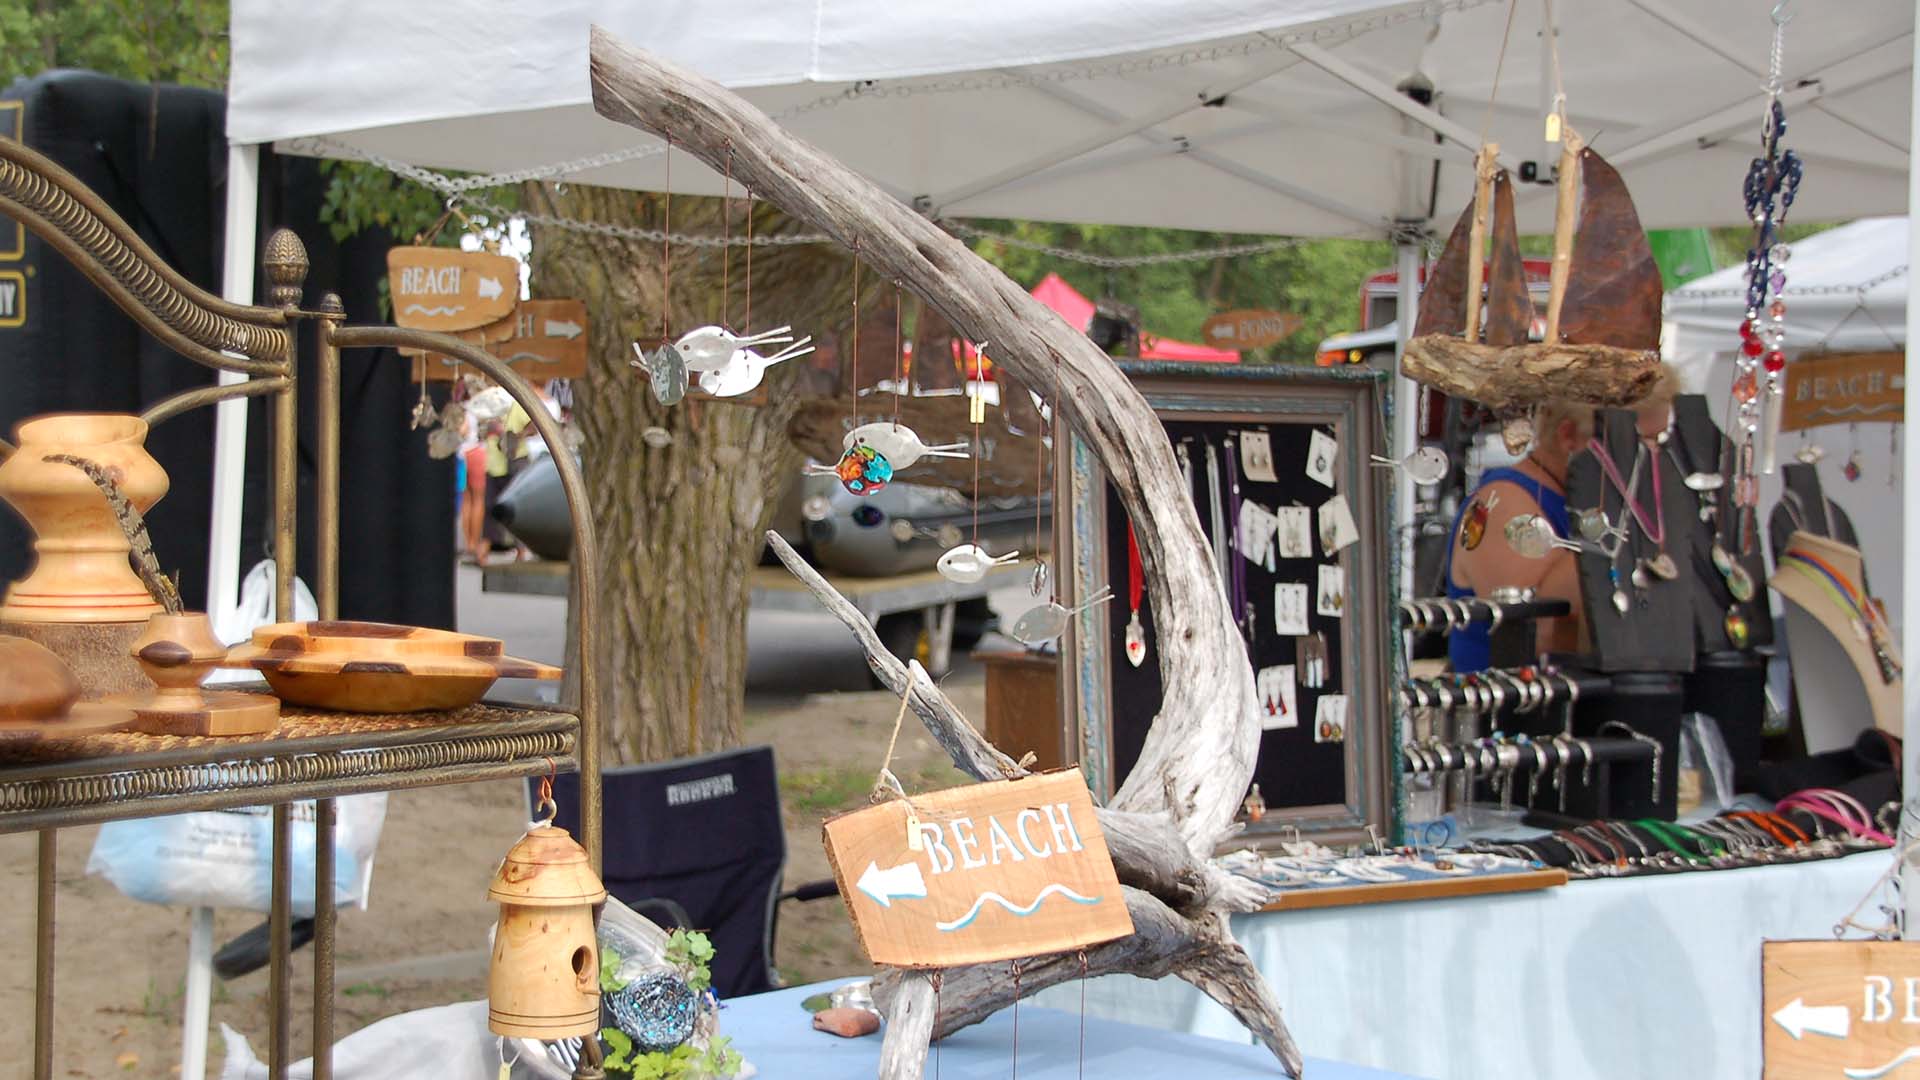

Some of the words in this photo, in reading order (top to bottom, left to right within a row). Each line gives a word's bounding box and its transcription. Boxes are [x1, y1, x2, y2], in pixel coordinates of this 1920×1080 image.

[400, 265, 461, 295] BEACH
[1239, 318, 1283, 341] POND
[1796, 369, 1884, 401] BEACH
[920, 802, 1085, 875] BEACH
